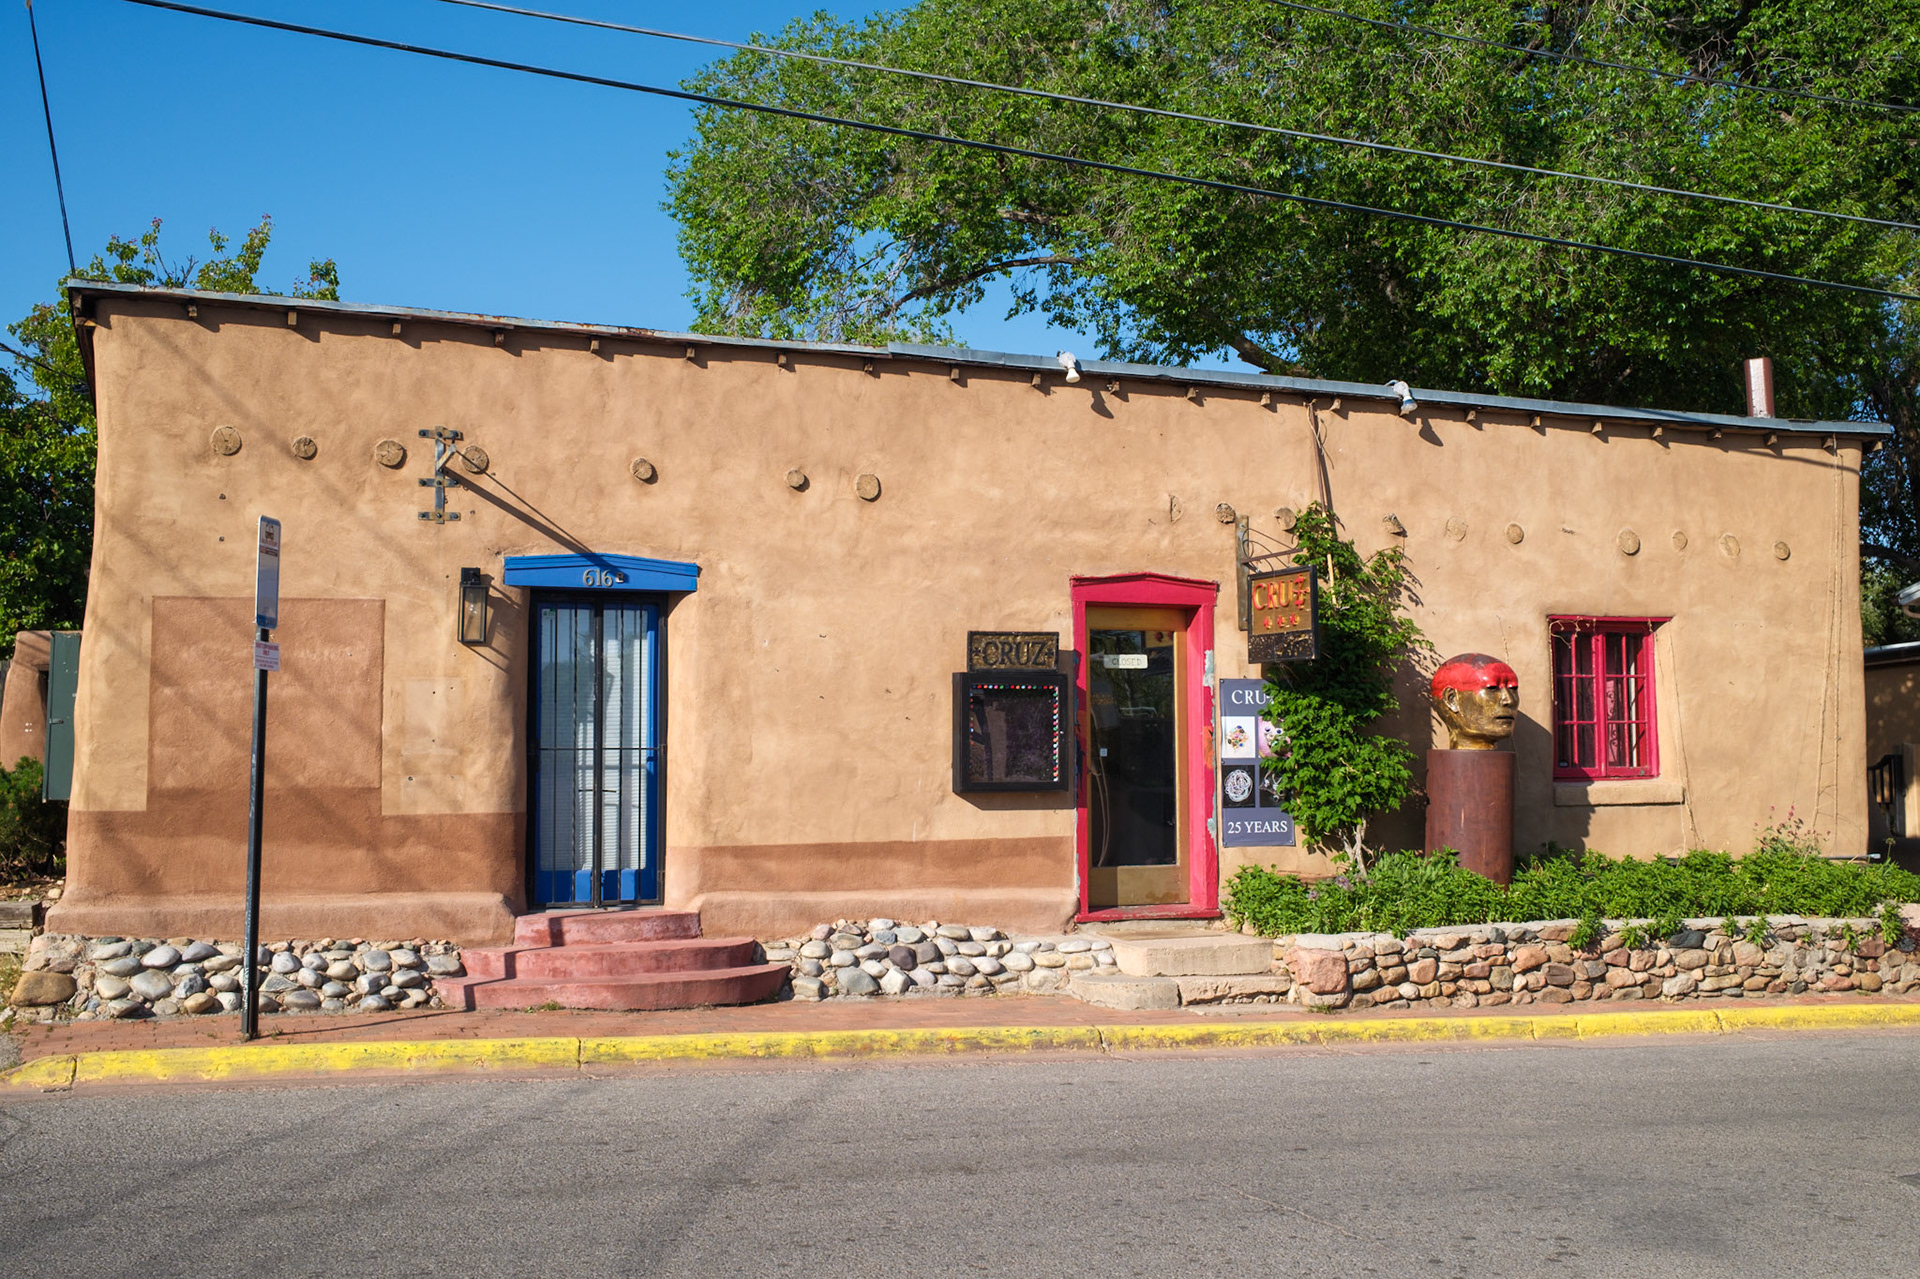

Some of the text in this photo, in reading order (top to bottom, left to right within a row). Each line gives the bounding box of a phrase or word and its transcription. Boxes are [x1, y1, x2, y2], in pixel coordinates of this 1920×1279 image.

[582, 569, 613, 587] 616
[1252, 574, 1310, 611] CRUZ
[982, 640, 1048, 666] CRUZ
[1111, 658, 1142, 666] CLOSED
[1231, 689, 1274, 705] CRU
[1227, 820, 1288, 834] 25 YEARS
